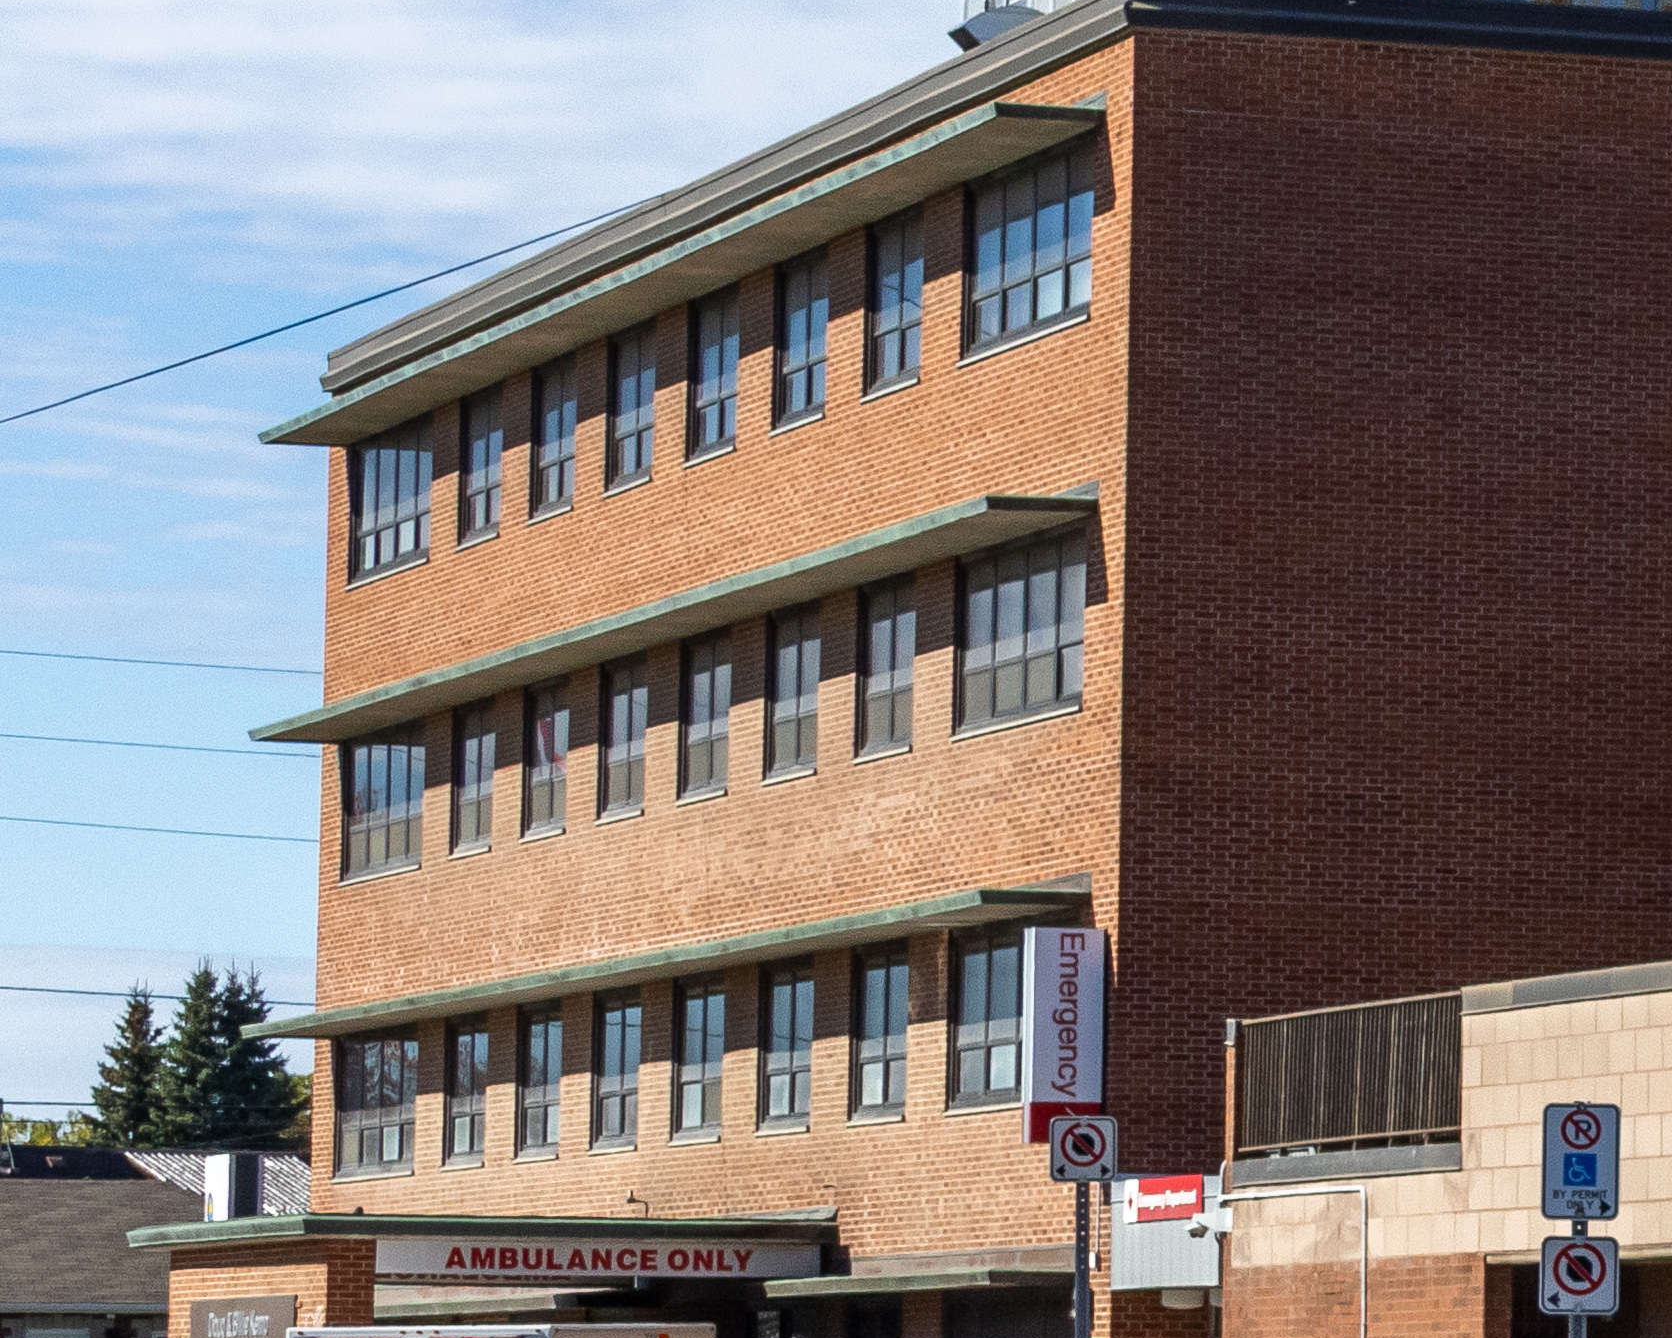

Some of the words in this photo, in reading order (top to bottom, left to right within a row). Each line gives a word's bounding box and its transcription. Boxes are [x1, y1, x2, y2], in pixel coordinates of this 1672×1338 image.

[1051, 932, 1086, 1098] Emergency
[1553, 1190, 1568, 1200] BY
[1571, 1190, 1609, 1200] PERMIT
[445, 1247, 659, 1272] AMBULANCE
[667, 1248, 754, 1273] ONLY
